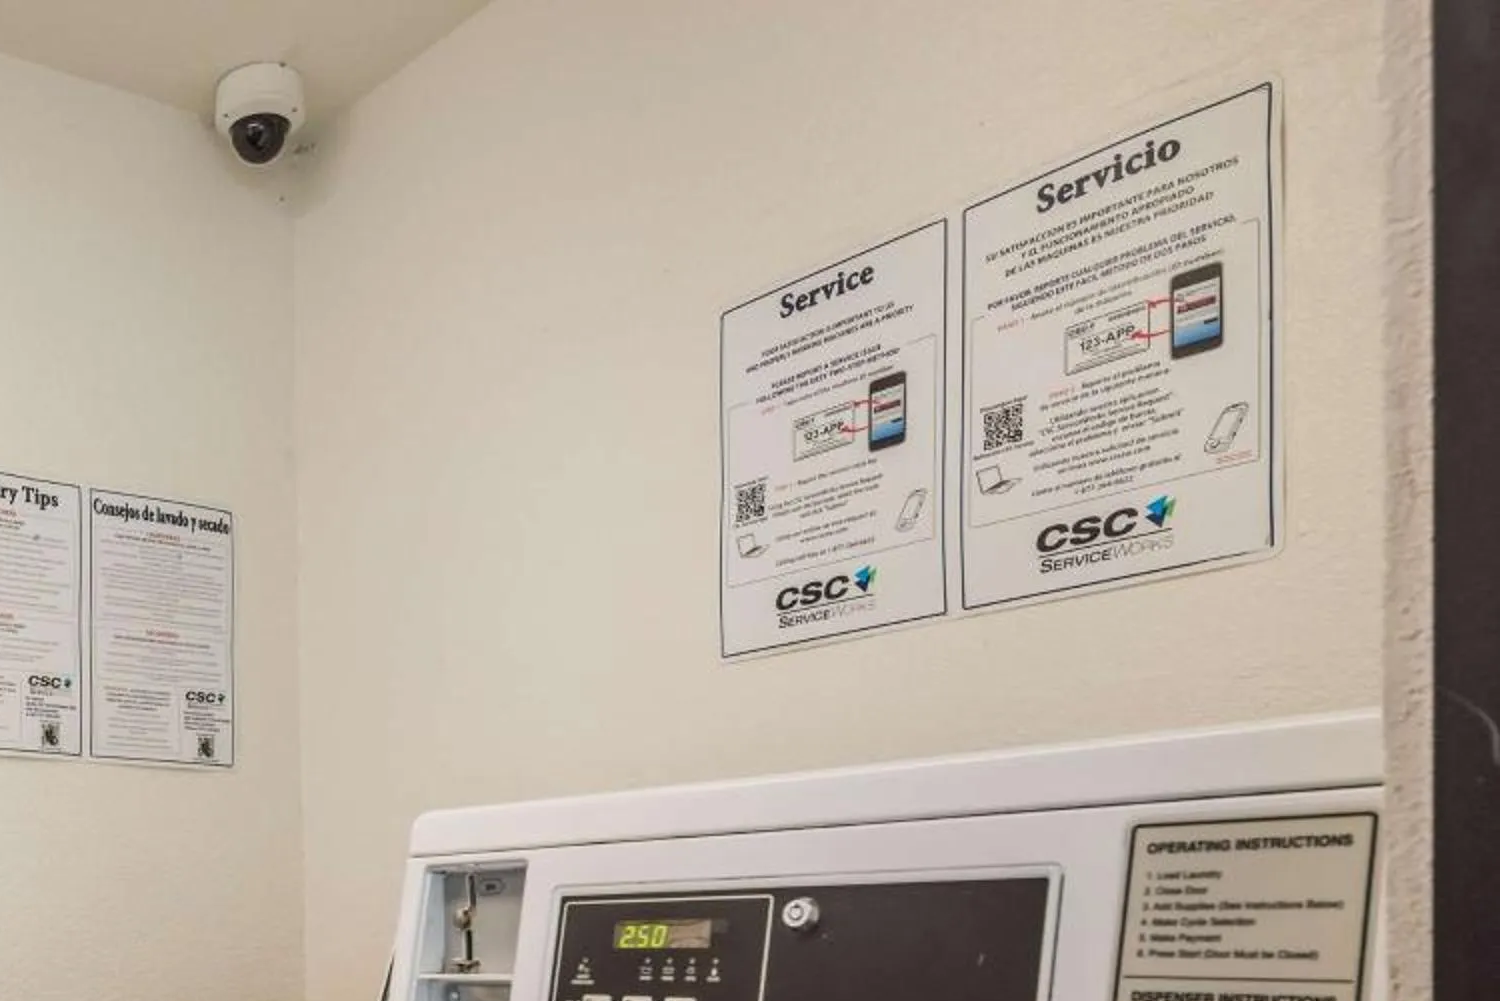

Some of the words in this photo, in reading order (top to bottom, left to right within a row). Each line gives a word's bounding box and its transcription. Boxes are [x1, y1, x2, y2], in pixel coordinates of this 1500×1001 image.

[1037, 138, 1181, 213] Servicio
[1079, 194, 1144, 223] IMPORTANTE
[1146, 182, 1174, 197] PARA
[1177, 156, 1239, 185] NOSOTROS
[1131, 186, 1194, 214] APROPIADO
[780, 265, 875, 319] Service
[22, 485, 59, 510] Tips
[93, 498, 140, 522] Consejos
[141, 504, 155, 522] de
[155, 507, 188, 528] lavado
[191, 518, 198, 533] y
[198, 515, 230, 535] secado
[1036, 507, 1139, 553] CSC
[775, 575, 850, 611] CSC
[28, 675, 62, 689] CSC
[185, 691, 216, 703] CSC
[1147, 840, 1231, 854] OPERATING
[1235, 834, 1354, 852] INSTRUCTIONS
[1156, 870, 1181, 880] Load
[1183, 870, 1222, 881] Laundry
[1155, 886, 1182, 896] Close
[1185, 886, 1208, 895] Door
[1153, 901, 1172, 910] Add
[1174, 901, 1216, 912] Supplies
[1218, 900, 1242, 911] (See
[1244, 900, 1303, 910] Instructions
[1305, 899, 1344, 910] Below)
[1152, 918, 1178, 927] Make
[1180, 917, 1207, 928] Cycle
[1210, 917, 1256, 926] Selection
[1150, 934, 1176, 942] Make
[1178, 933, 1222, 944] Payment
[1149, 950, 1176, 959] Press
[1177, 950, 1200, 959] Start
[1204, 950, 1231, 960] (Door
[1233, 950, 1259, 960] Must
[1261, 950, 1275, 960] be
[1277, 950, 1319, 961] Closed)
